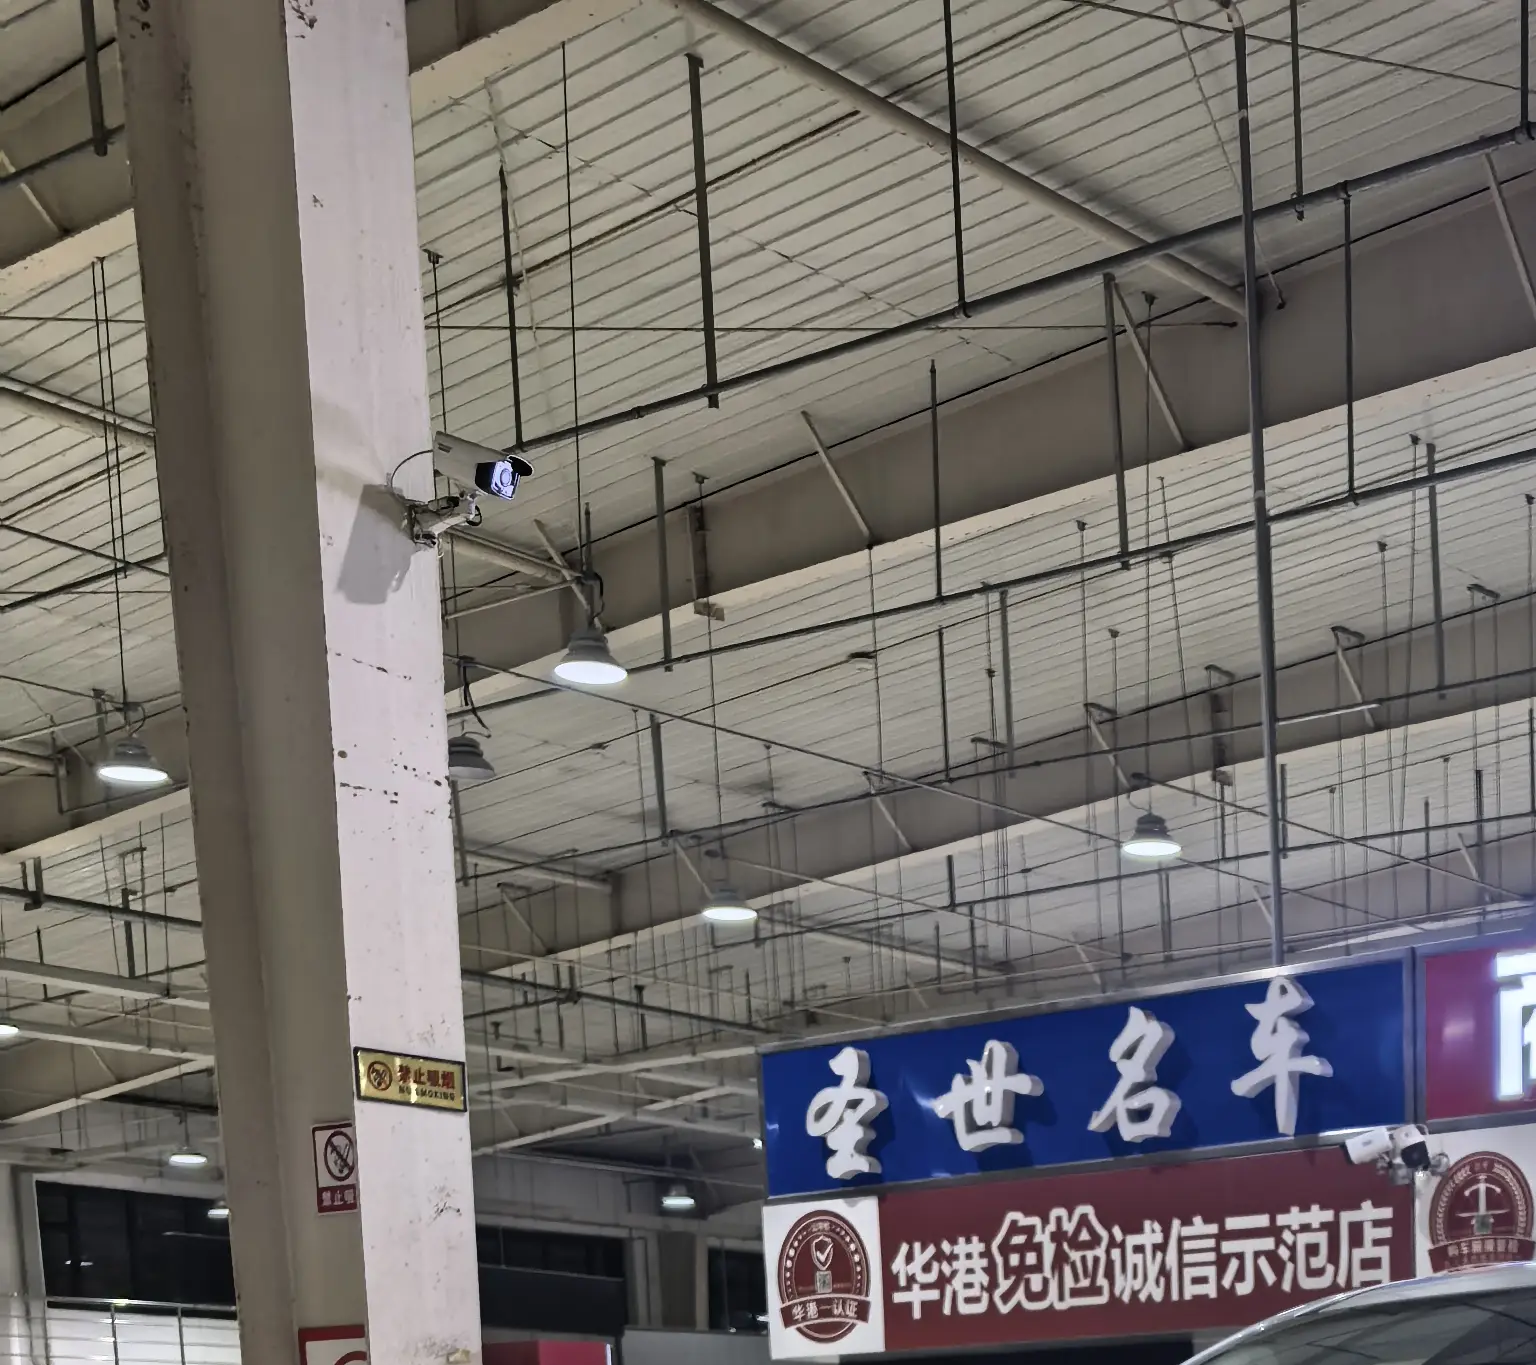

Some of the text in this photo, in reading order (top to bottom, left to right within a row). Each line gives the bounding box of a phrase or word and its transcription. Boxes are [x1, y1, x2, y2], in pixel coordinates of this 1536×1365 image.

[806, 975, 1333, 1179] 圣世名车
[891, 1199, 1394, 1322] 华港免检诚信示范店
